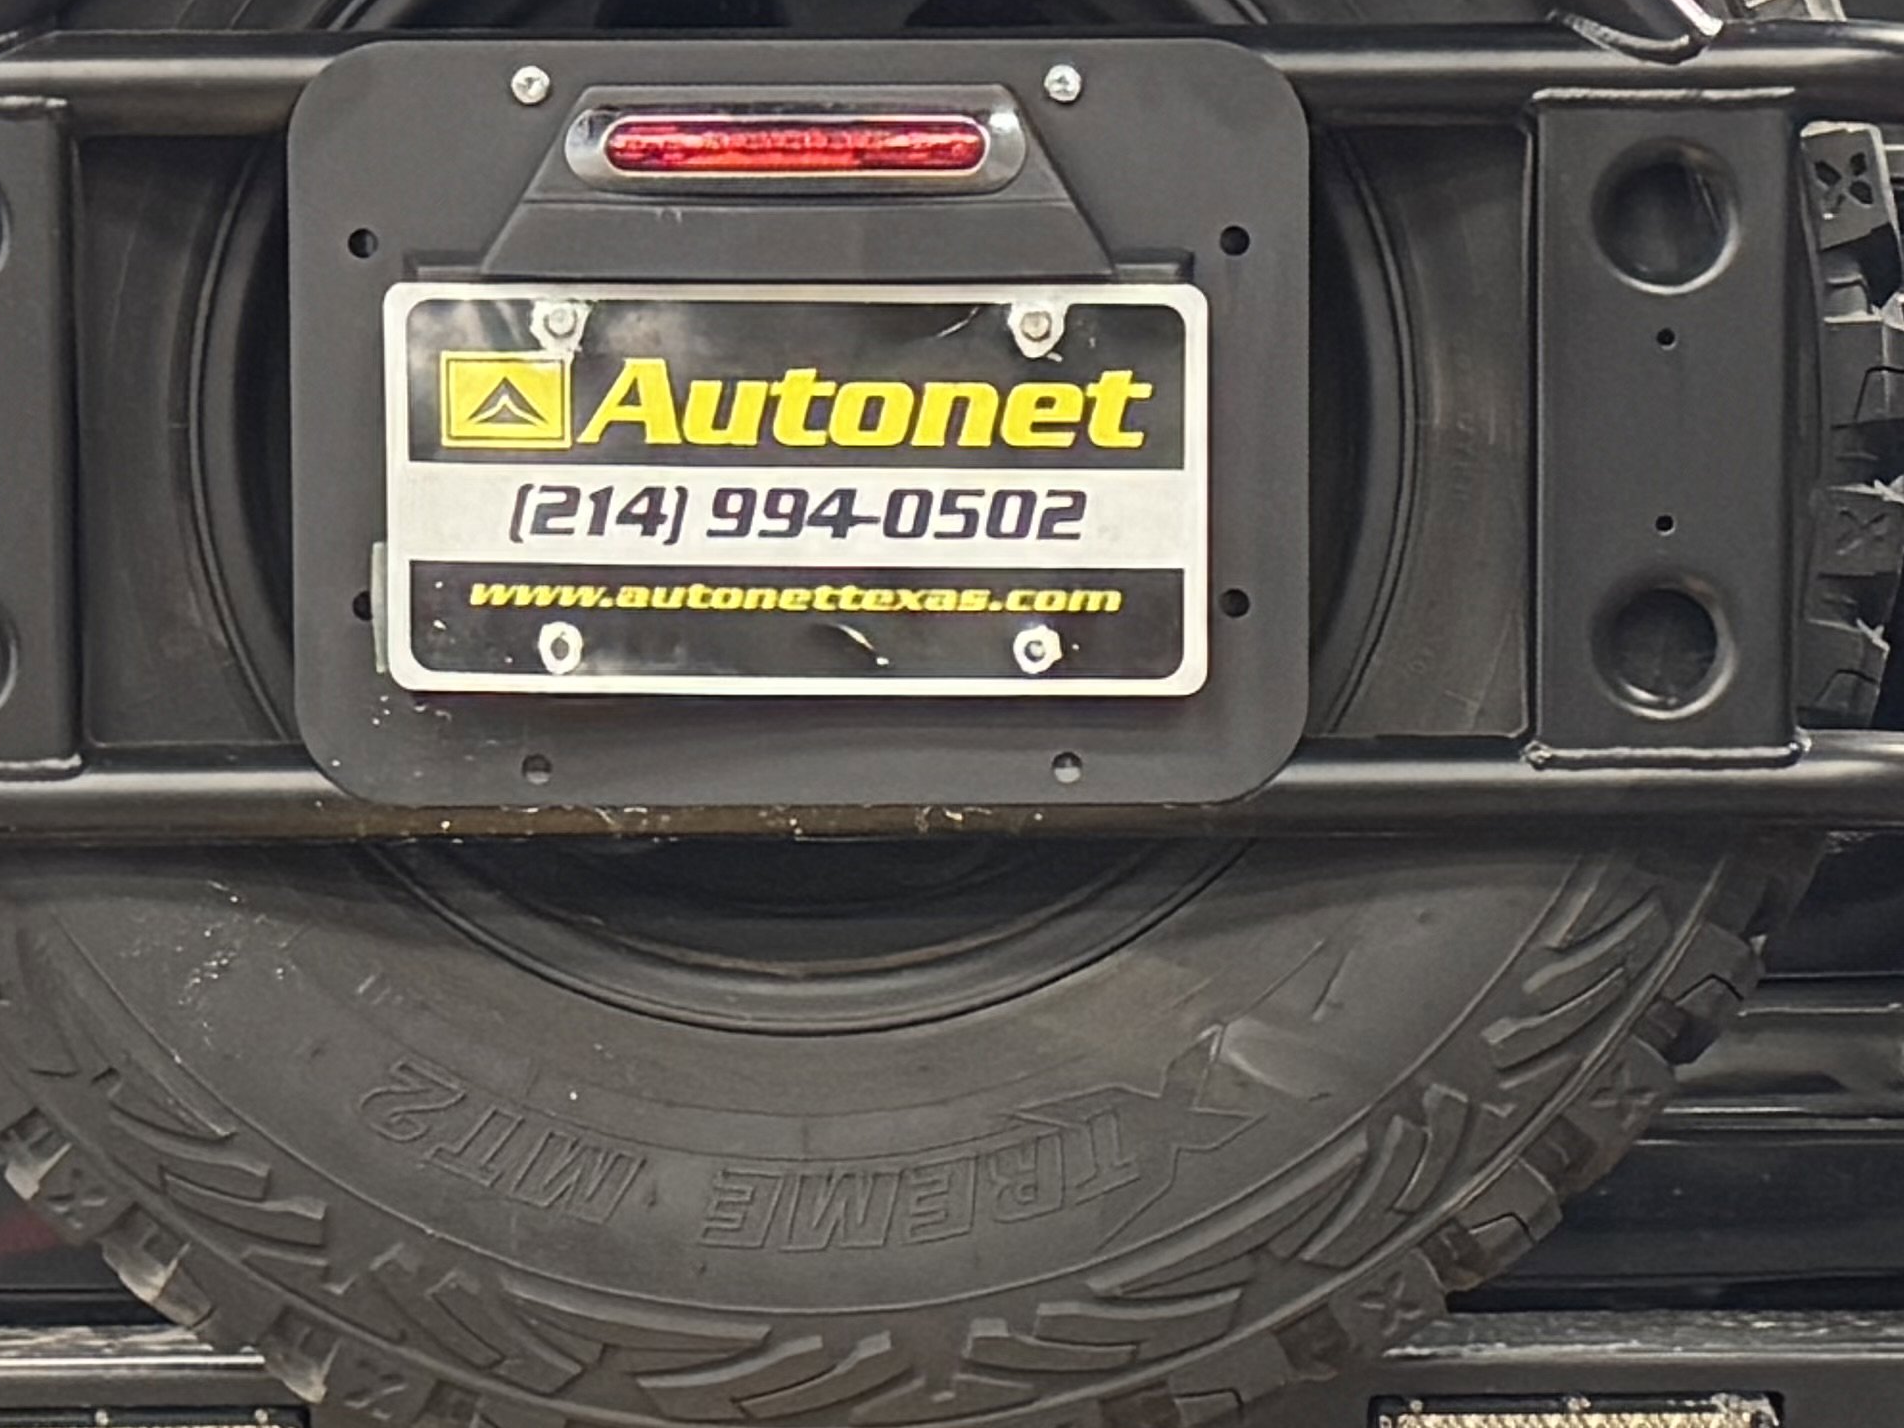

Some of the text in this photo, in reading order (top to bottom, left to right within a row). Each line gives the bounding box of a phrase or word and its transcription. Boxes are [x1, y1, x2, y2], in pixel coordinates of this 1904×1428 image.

[578, 358, 1153, 448] Autonet
[509, 482, 1088, 546] (214) 994-0502
[469, 582, 1122, 614] www.autonettexas.com
[358, 1022, 1268, 1252] XTREME MT2
